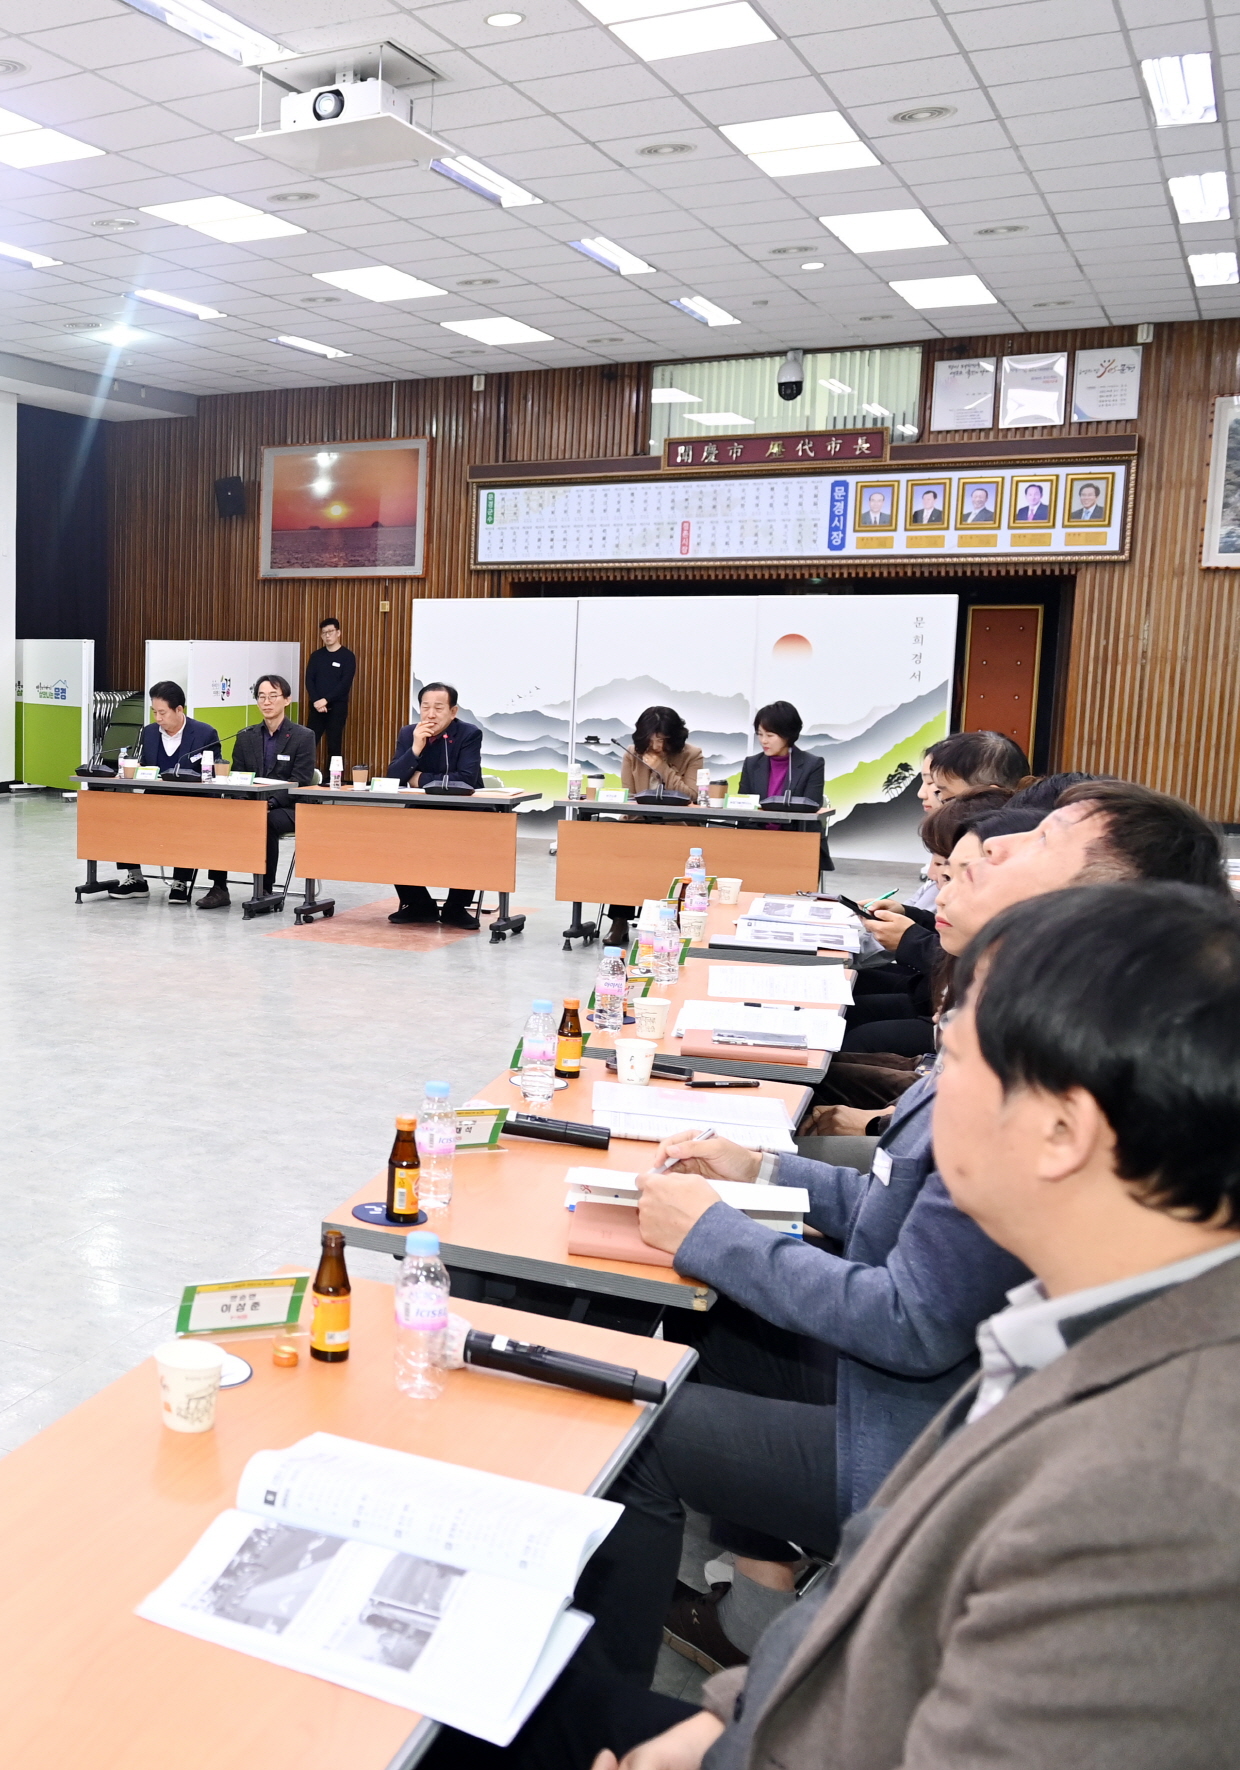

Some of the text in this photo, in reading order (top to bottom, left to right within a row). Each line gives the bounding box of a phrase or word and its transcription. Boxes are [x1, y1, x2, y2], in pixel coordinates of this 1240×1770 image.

[830, 485, 847, 546] 문경시장
[909, 616, 926, 682] 문희경서
[54, 687, 67, 700] 문경
